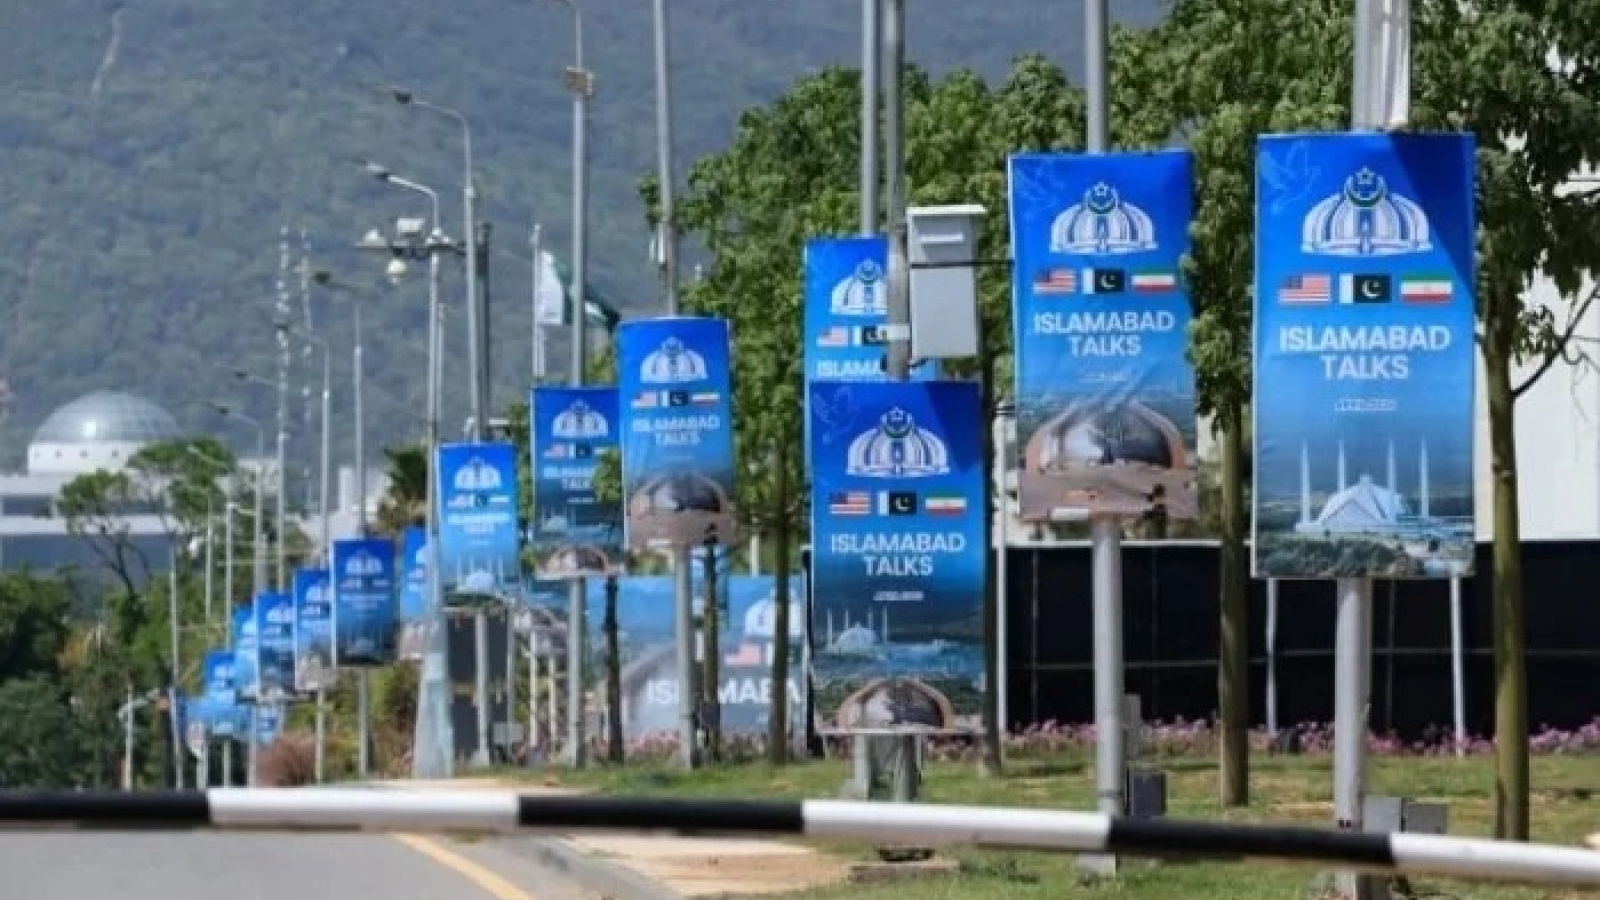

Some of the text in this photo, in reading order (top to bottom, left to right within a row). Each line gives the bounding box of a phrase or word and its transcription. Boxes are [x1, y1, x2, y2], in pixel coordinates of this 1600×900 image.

[1033, 310, 1175, 333] ISLAMABAD
[1067, 334, 1141, 357] TALKS
[1279, 325, 1450, 351] ISLAMABAD
[817, 358, 888, 376] ISLAMA
[1319, 354, 1410, 380] TALKS
[831, 532, 967, 553] ISLAMABAD
[863, 554, 933, 577] TALKS
